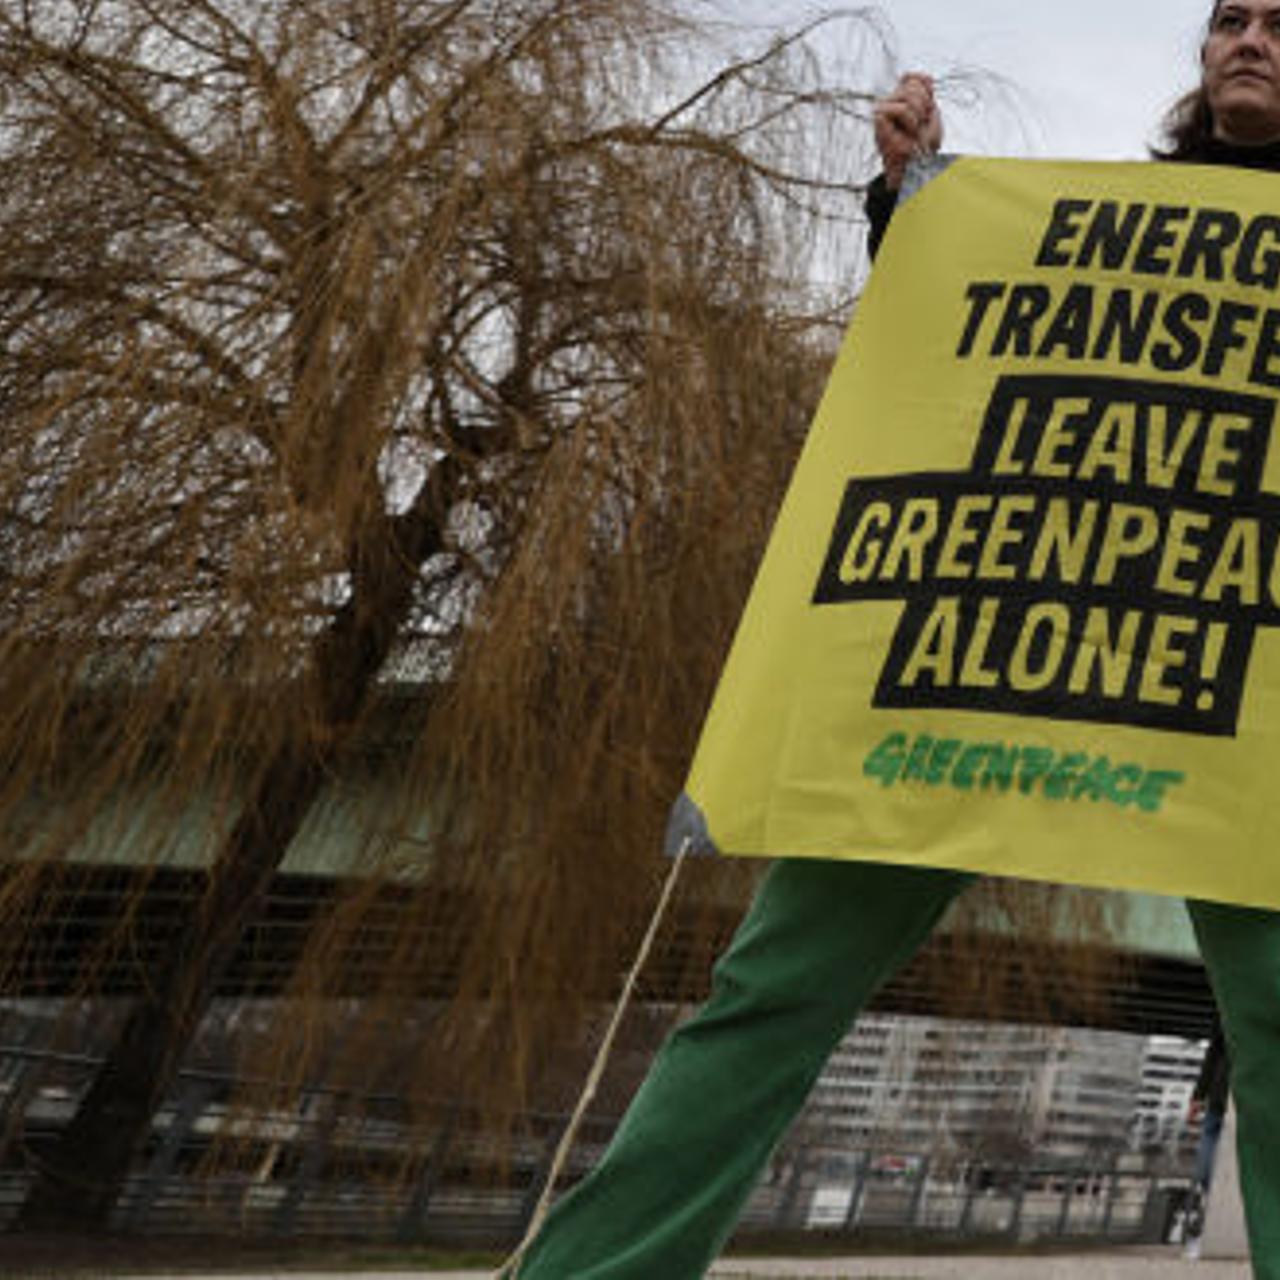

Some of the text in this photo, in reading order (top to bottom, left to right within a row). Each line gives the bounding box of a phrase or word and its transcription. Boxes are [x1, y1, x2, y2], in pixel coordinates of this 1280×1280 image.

[993, 395, 1253, 497] LEAVE
[898, 598, 1226, 711] ALONE!
[863, 731, 1185, 813] GREENPEACE
